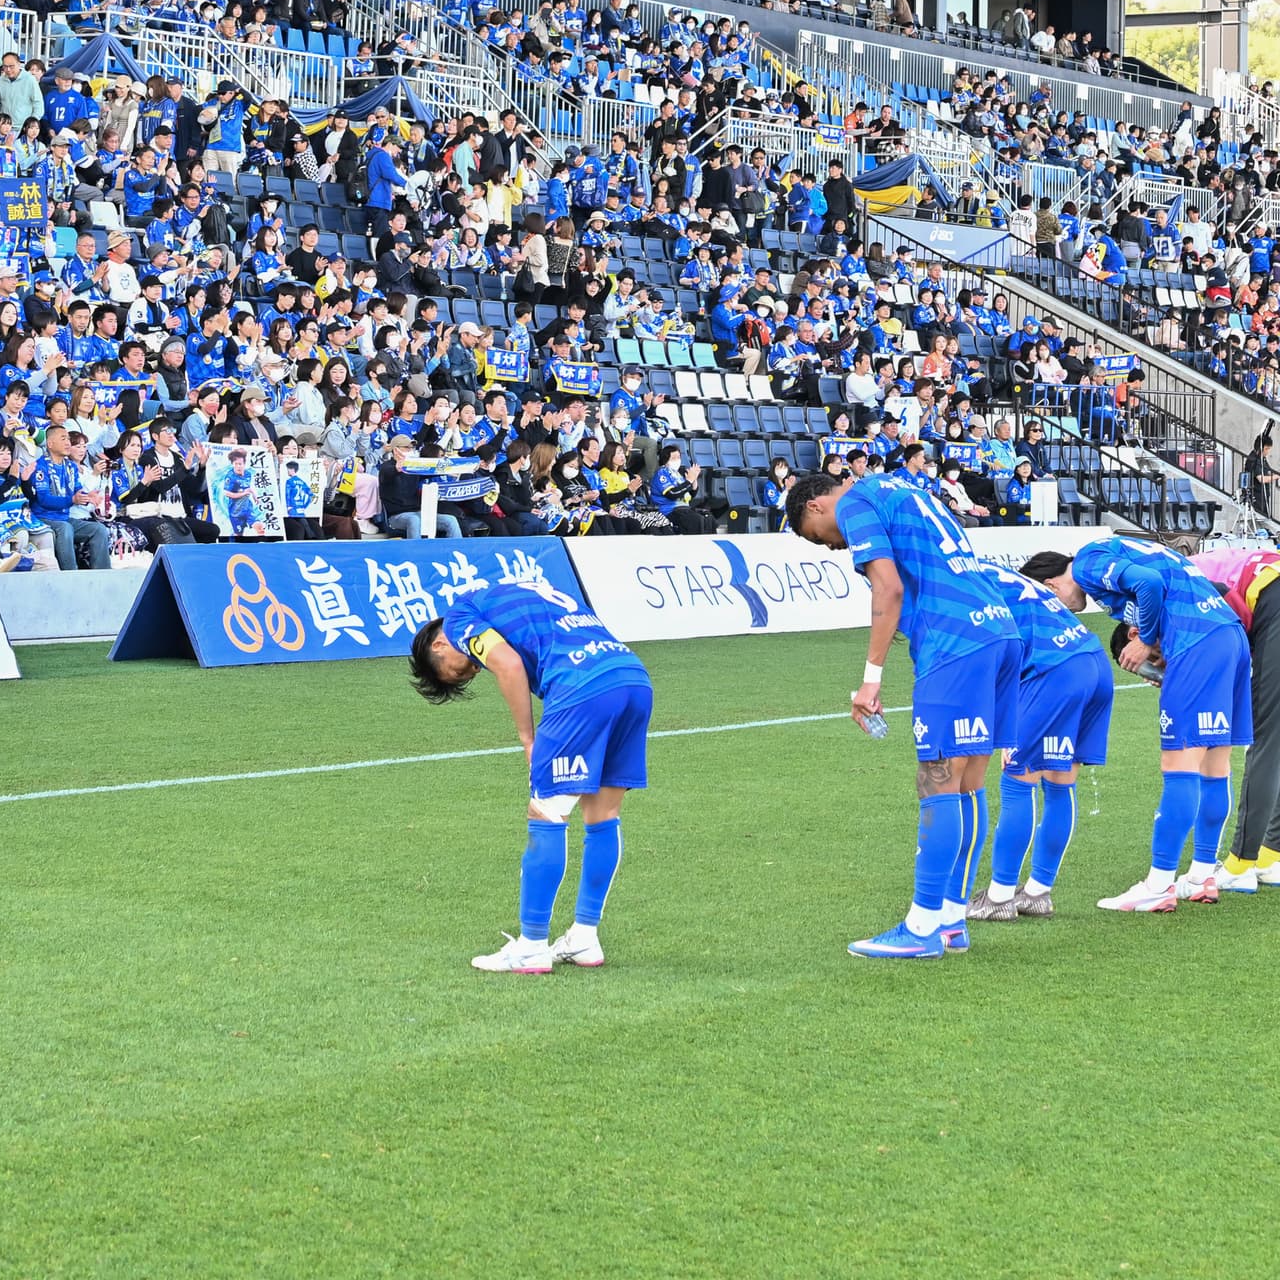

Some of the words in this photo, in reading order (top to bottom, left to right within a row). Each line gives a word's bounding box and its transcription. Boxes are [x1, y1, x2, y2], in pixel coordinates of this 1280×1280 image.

[55, 106, 66, 120] 12
[20, 182, 41, 205] 林
[7, 202, 44, 221] 誠道
